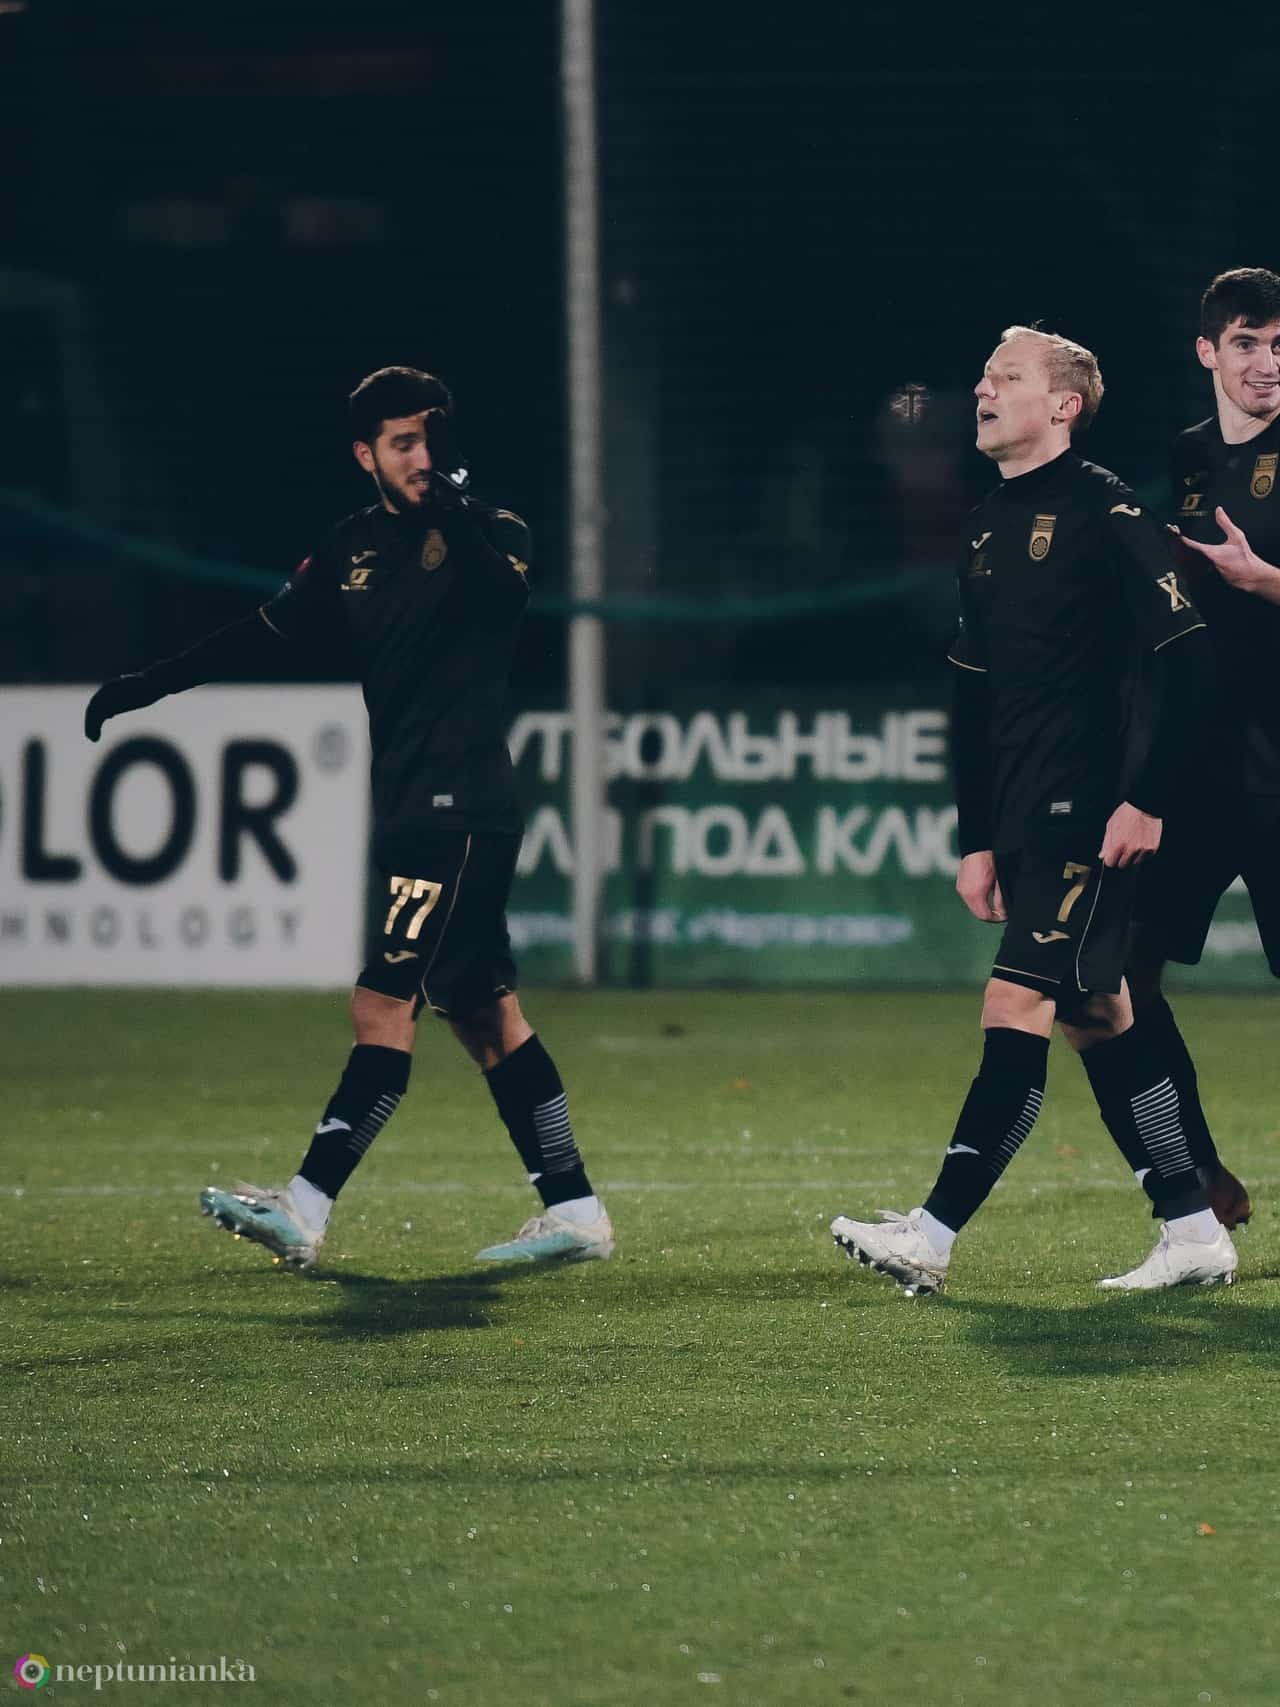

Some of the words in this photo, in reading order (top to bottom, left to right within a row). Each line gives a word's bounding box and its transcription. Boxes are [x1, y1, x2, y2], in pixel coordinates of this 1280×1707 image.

[0, 735, 303, 890] LOR
[638, 803, 805, 880] ПОД
[384, 875, 443, 939] 77
[1056, 860, 1091, 923] 7
